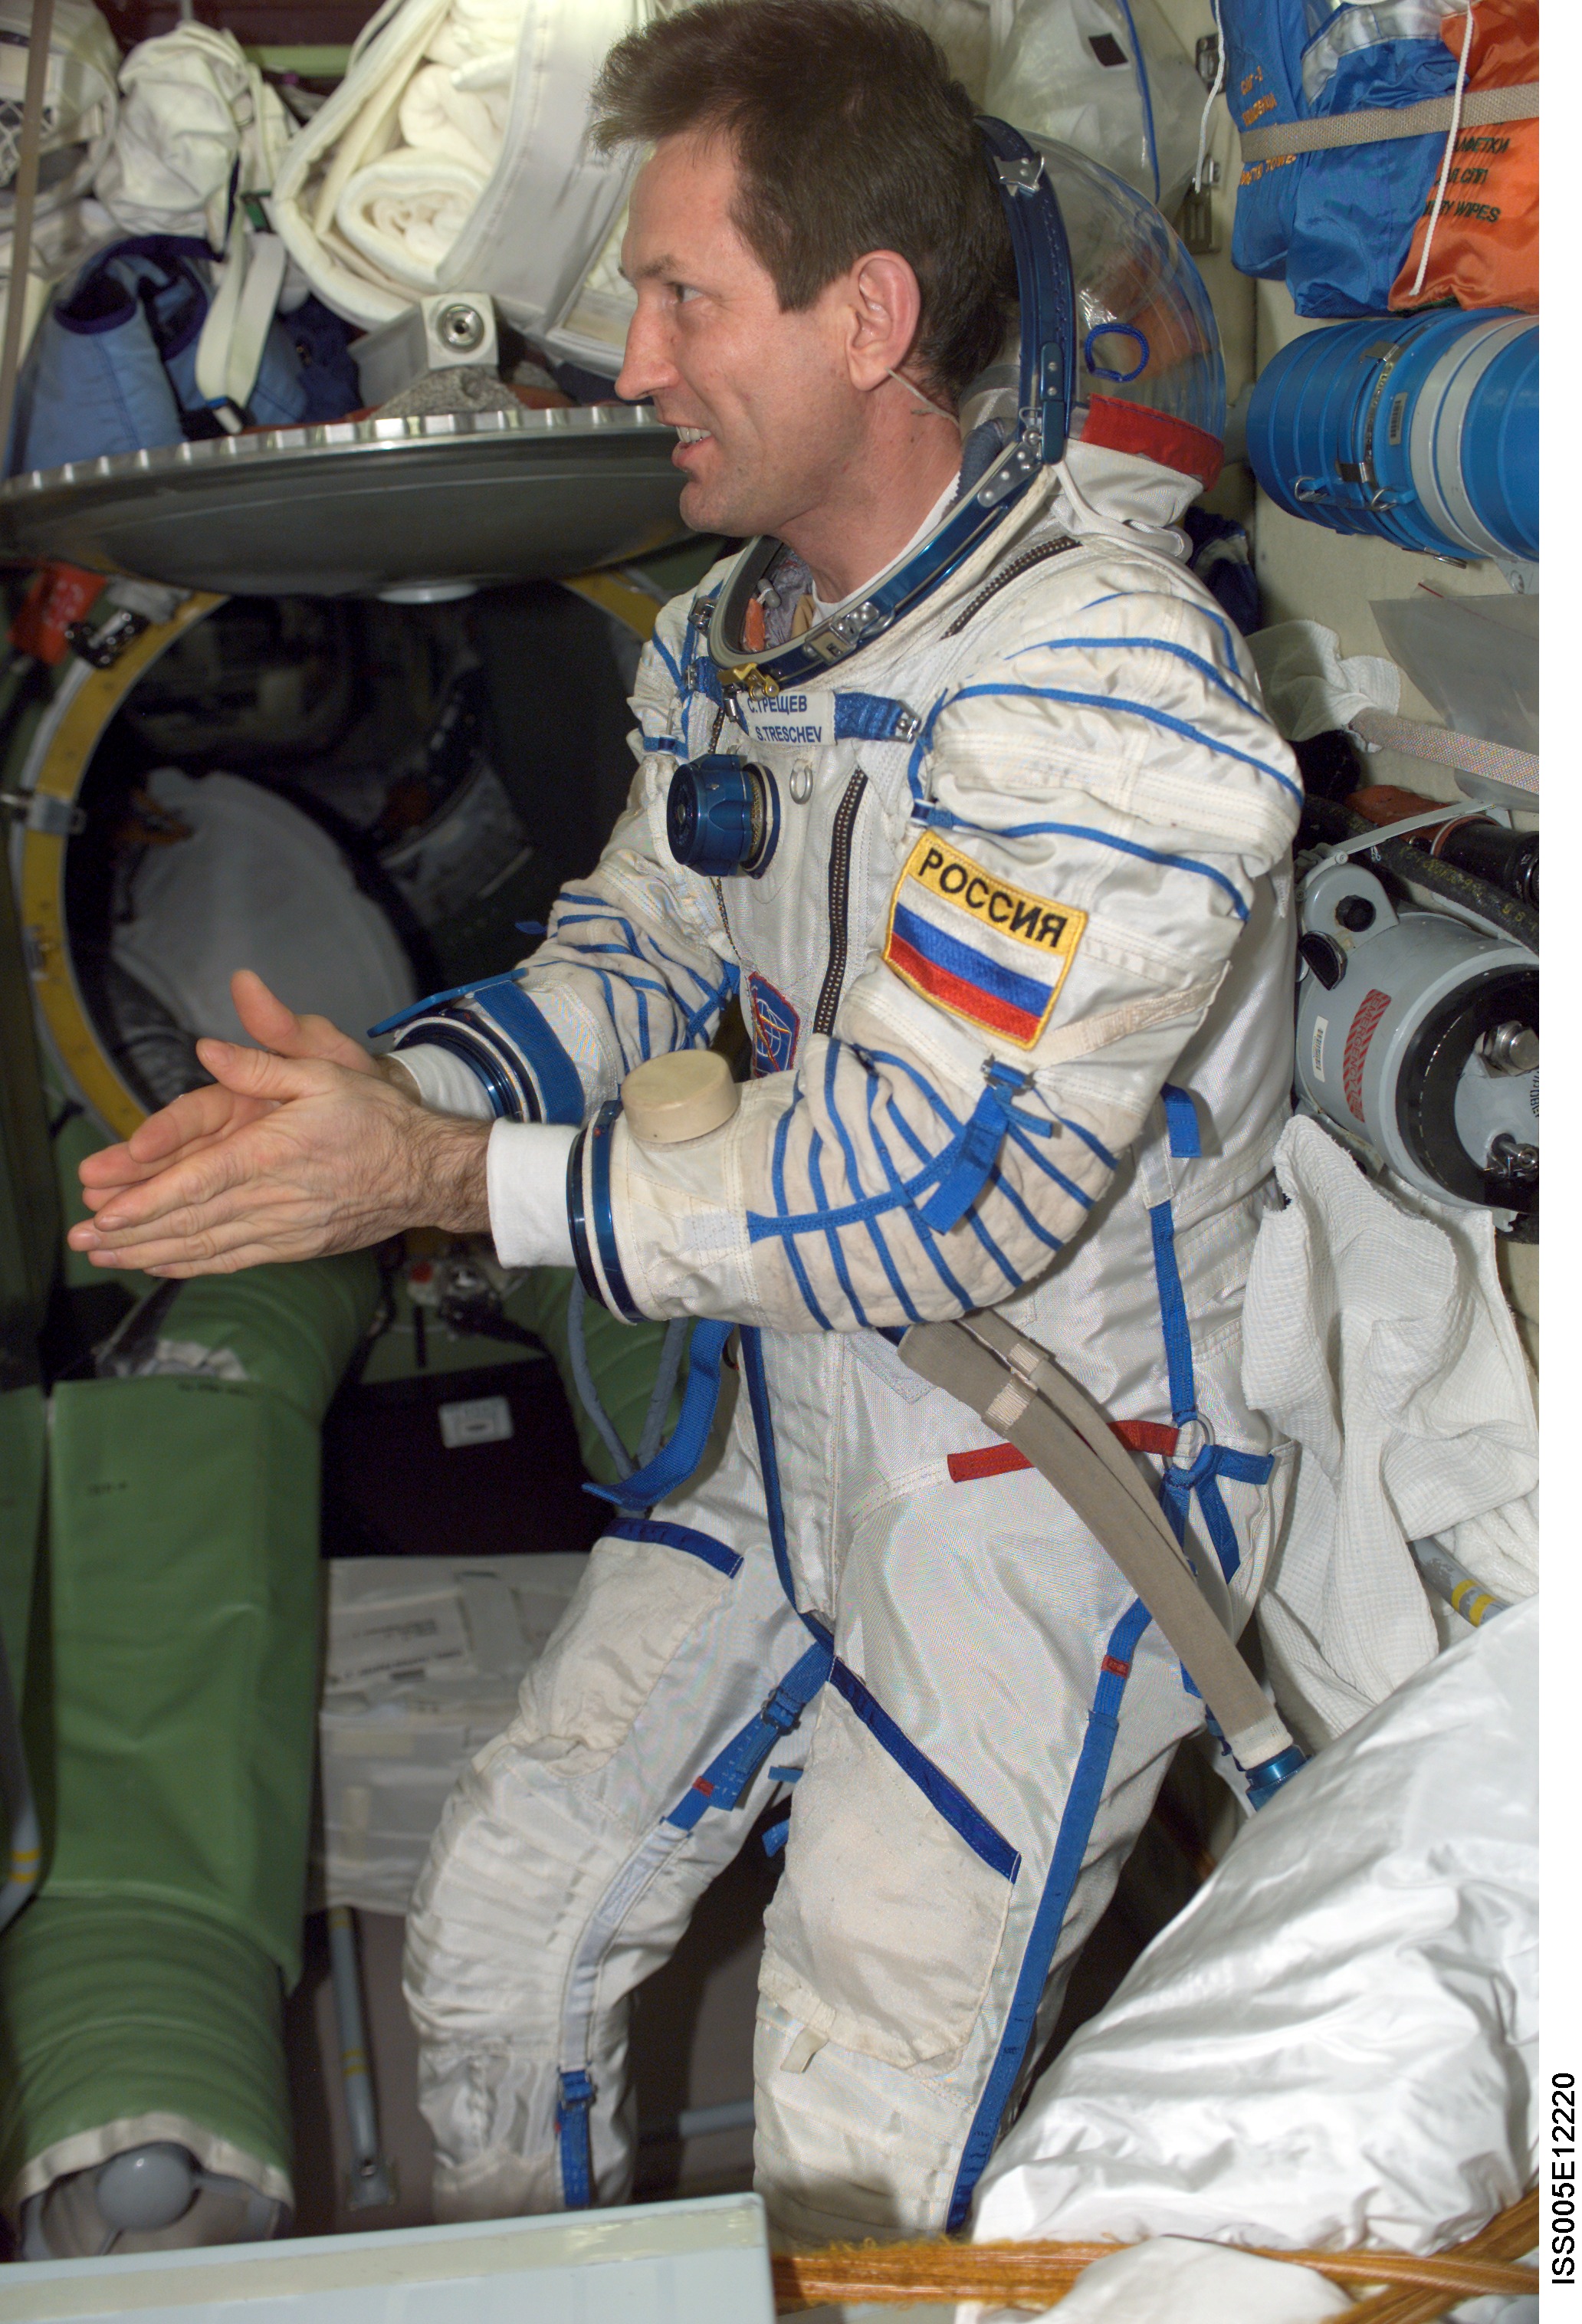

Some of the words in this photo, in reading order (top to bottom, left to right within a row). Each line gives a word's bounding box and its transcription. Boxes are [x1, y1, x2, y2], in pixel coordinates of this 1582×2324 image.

[1454, 201, 1501, 223] WIPES
[755, 725, 822, 743] S.TRESCHEV
[919, 848, 1068, 948] РОССИЯ
[1350, 996, 1382, 1087] EMERGENCY
